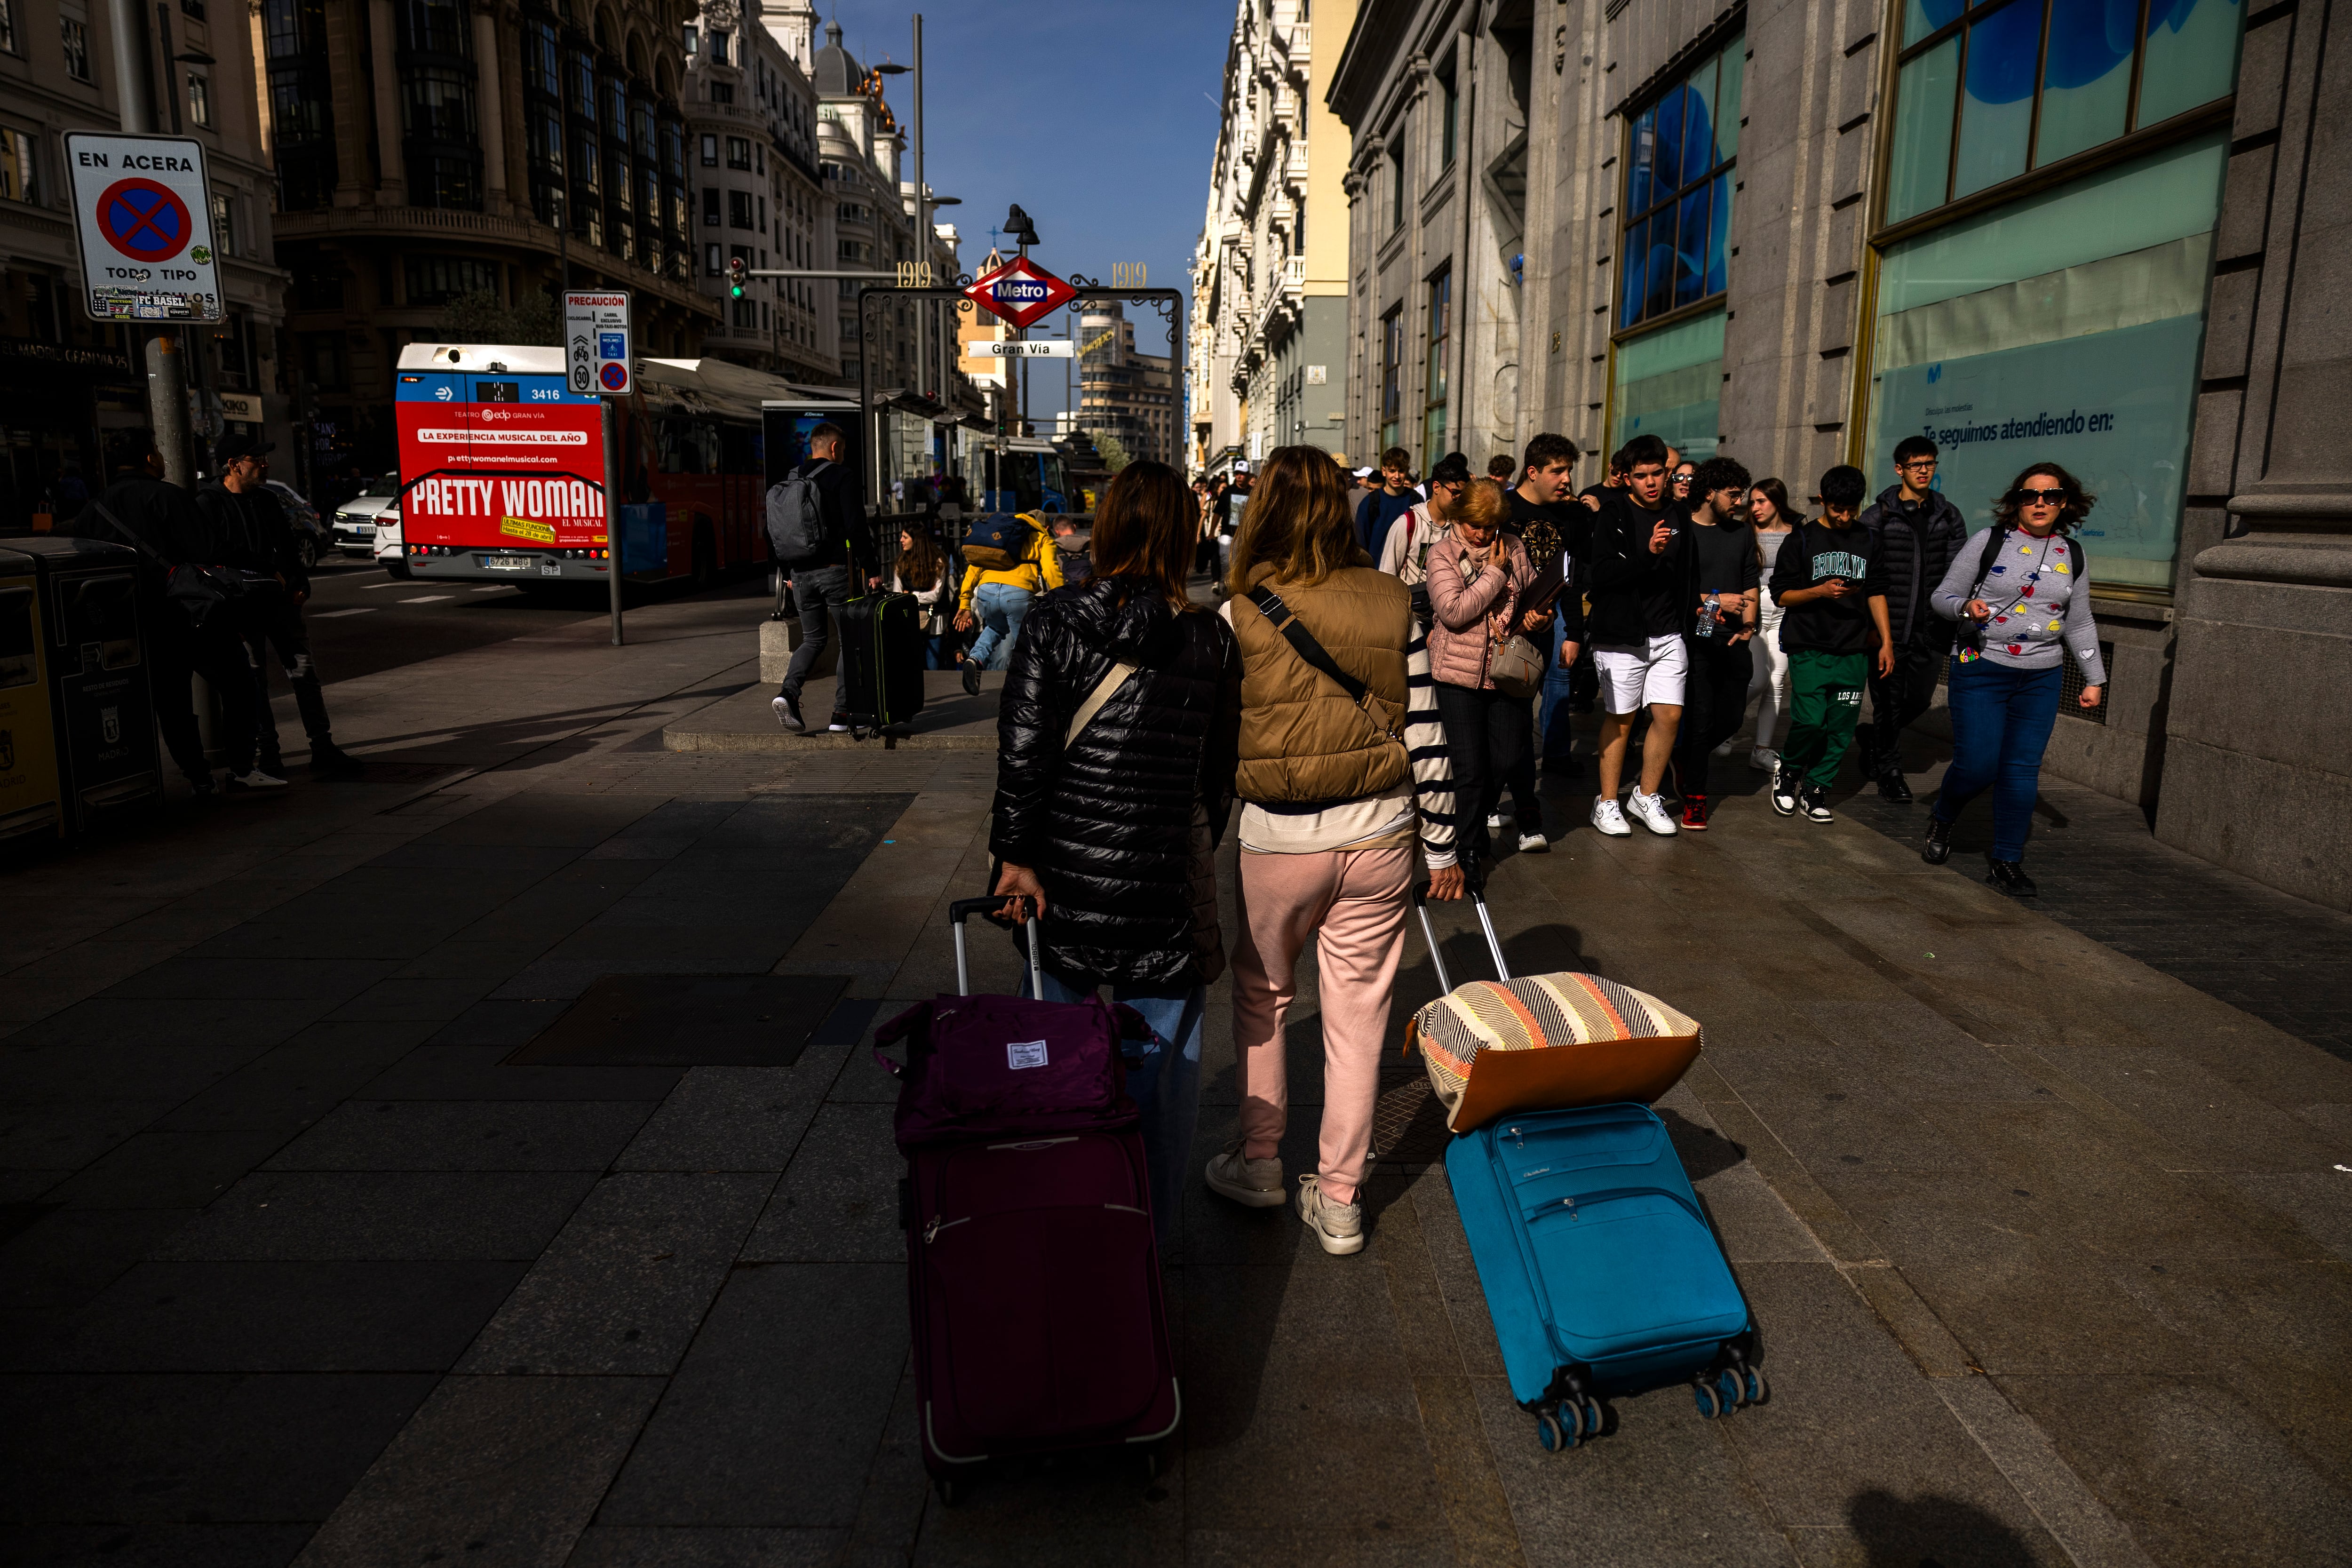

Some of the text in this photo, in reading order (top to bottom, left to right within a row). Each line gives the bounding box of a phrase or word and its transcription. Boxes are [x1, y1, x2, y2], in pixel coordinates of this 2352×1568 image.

[79, 152, 194, 172] EN ACERA
[105, 267, 151, 279] TODO
[160, 269, 197, 281] TIPO
[896, 261, 932, 287] 1919
[1112, 262, 1147, 288] 1919
[997, 283, 1044, 298] Metro
[139, 295, 151, 305] FC
[153, 296, 185, 307] BASEL
[568, 295, 624, 306] PRECAUCIÓN
[992, 344, 1050, 354] Gran Vía
[18, 343, 63, 361] MADRID
[115, 356, 127, 369] 25
[578, 371, 587, 384] 30
[532, 389, 560, 400] 3416
[222, 399, 248, 412] KIKO
[1925, 406, 1944, 416] Disculpa
[1952, 403, 1973, 413] molestias
[494, 409, 511, 421] edp
[314, 422, 336, 436] EANS
[1923, 409, 2114, 450] Te seguimos atendiendo en:
[437, 432, 495, 441] EXPERIENCIA
[560, 433, 581, 442] AÑO
[448, 455, 558, 464] prettywomanelmusical.com
[411, 478, 604, 517] PRETTY WOMAN
[525, 523, 554, 533] FUNCIONE
[562, 518, 603, 527] EL MUSICAL
[490, 557, 529, 566] 6726 MBG
[1812, 551, 1867, 581] BROOKLYN
[82, 684, 98, 692] RESTO
[105, 678, 129, 687] RESIDUOS
[1837, 692, 1851, 700] LOS
[98, 747, 129, 761] MADRID
